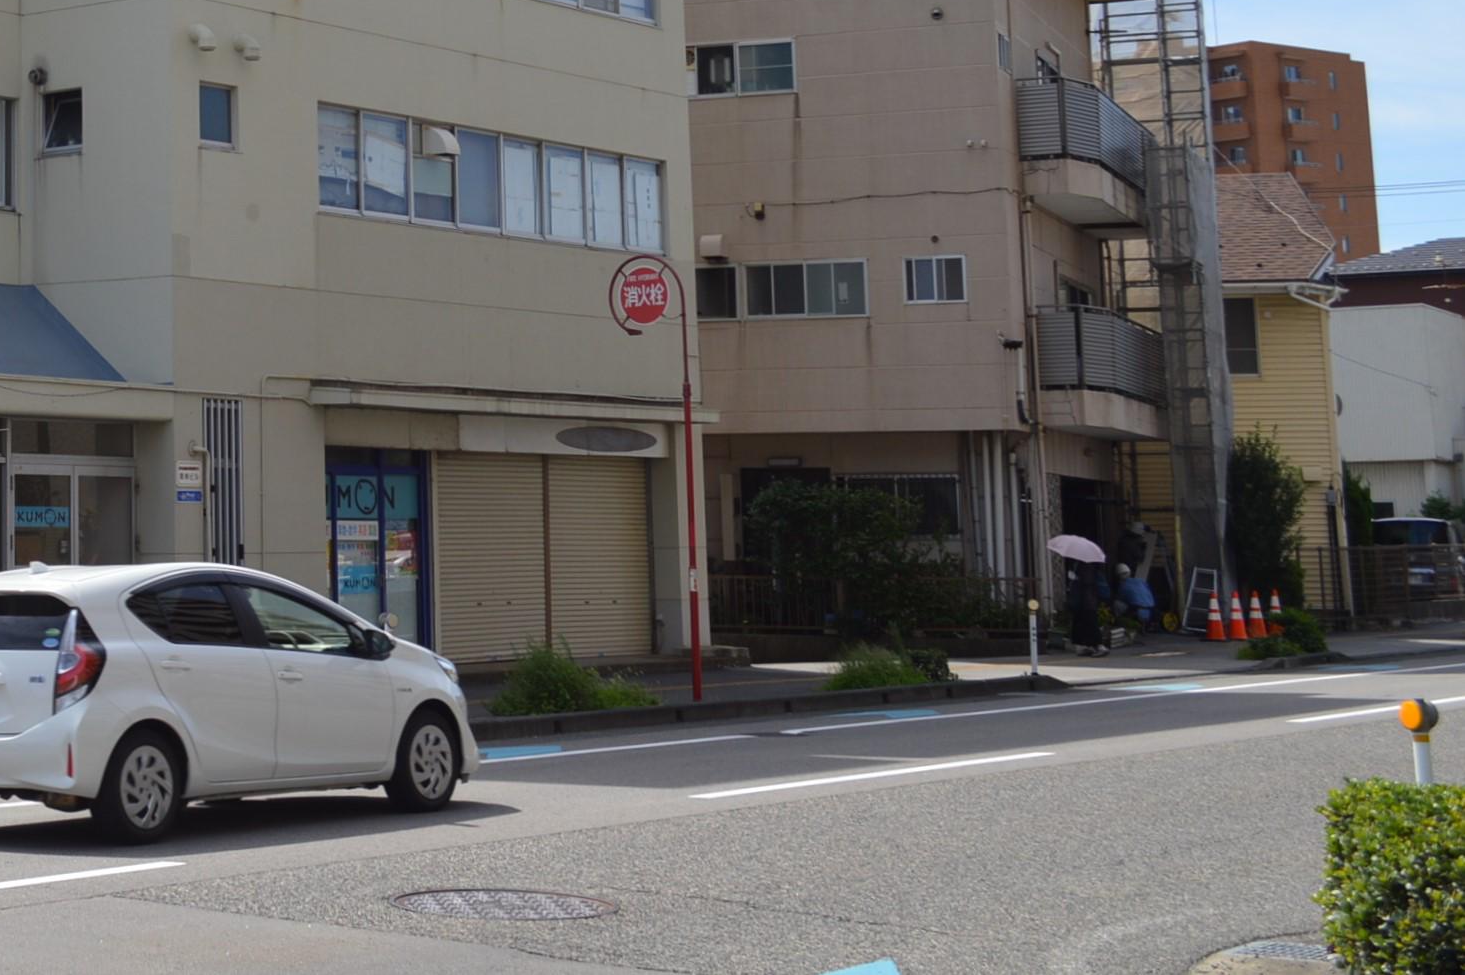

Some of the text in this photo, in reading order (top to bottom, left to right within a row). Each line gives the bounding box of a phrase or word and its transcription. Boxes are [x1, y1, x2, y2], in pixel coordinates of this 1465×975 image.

[623, 283, 665, 308] 消火栓
[326, 478, 396, 515] MON
[16, 508, 67, 526] KUMON
[343, 576, 376, 590] KUMON
